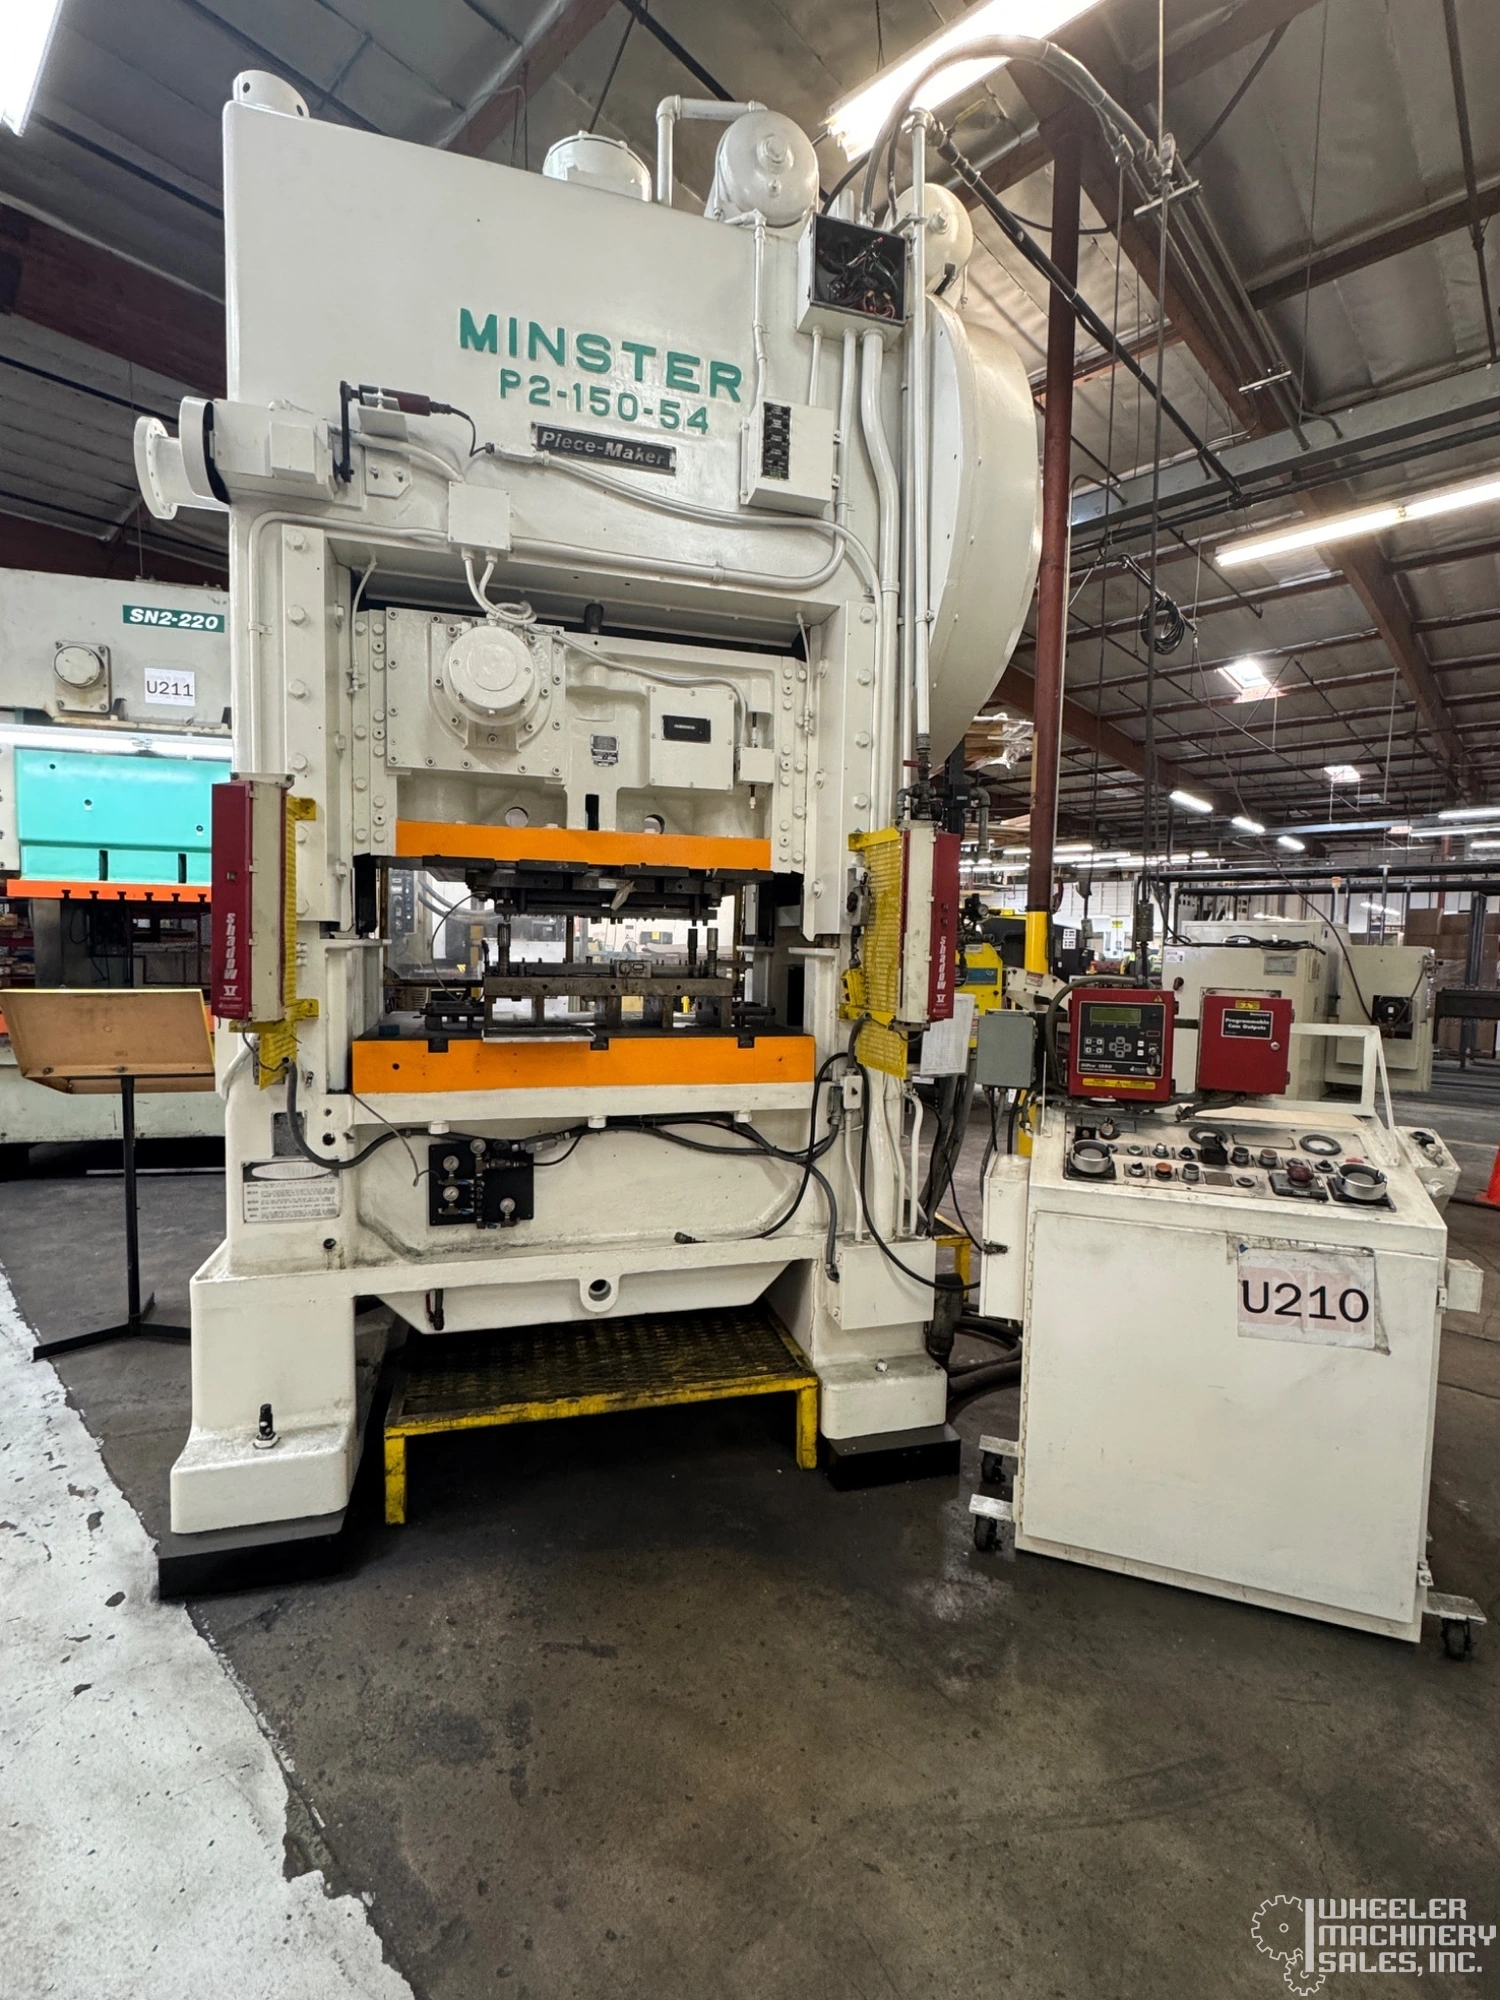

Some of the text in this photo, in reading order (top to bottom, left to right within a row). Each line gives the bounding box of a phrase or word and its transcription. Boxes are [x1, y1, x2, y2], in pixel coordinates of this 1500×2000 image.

[459, 307, 743, 403] MINSTER
[500, 368, 709, 435] P2-150-54
[540, 430, 665, 466] Piece-Maker
[129, 608, 219, 630] SN2-220
[146, 680, 193, 697] U211
[1225, 1017, 1270, 1025] Programmable
[1242, 1279, 1369, 1323] U210
